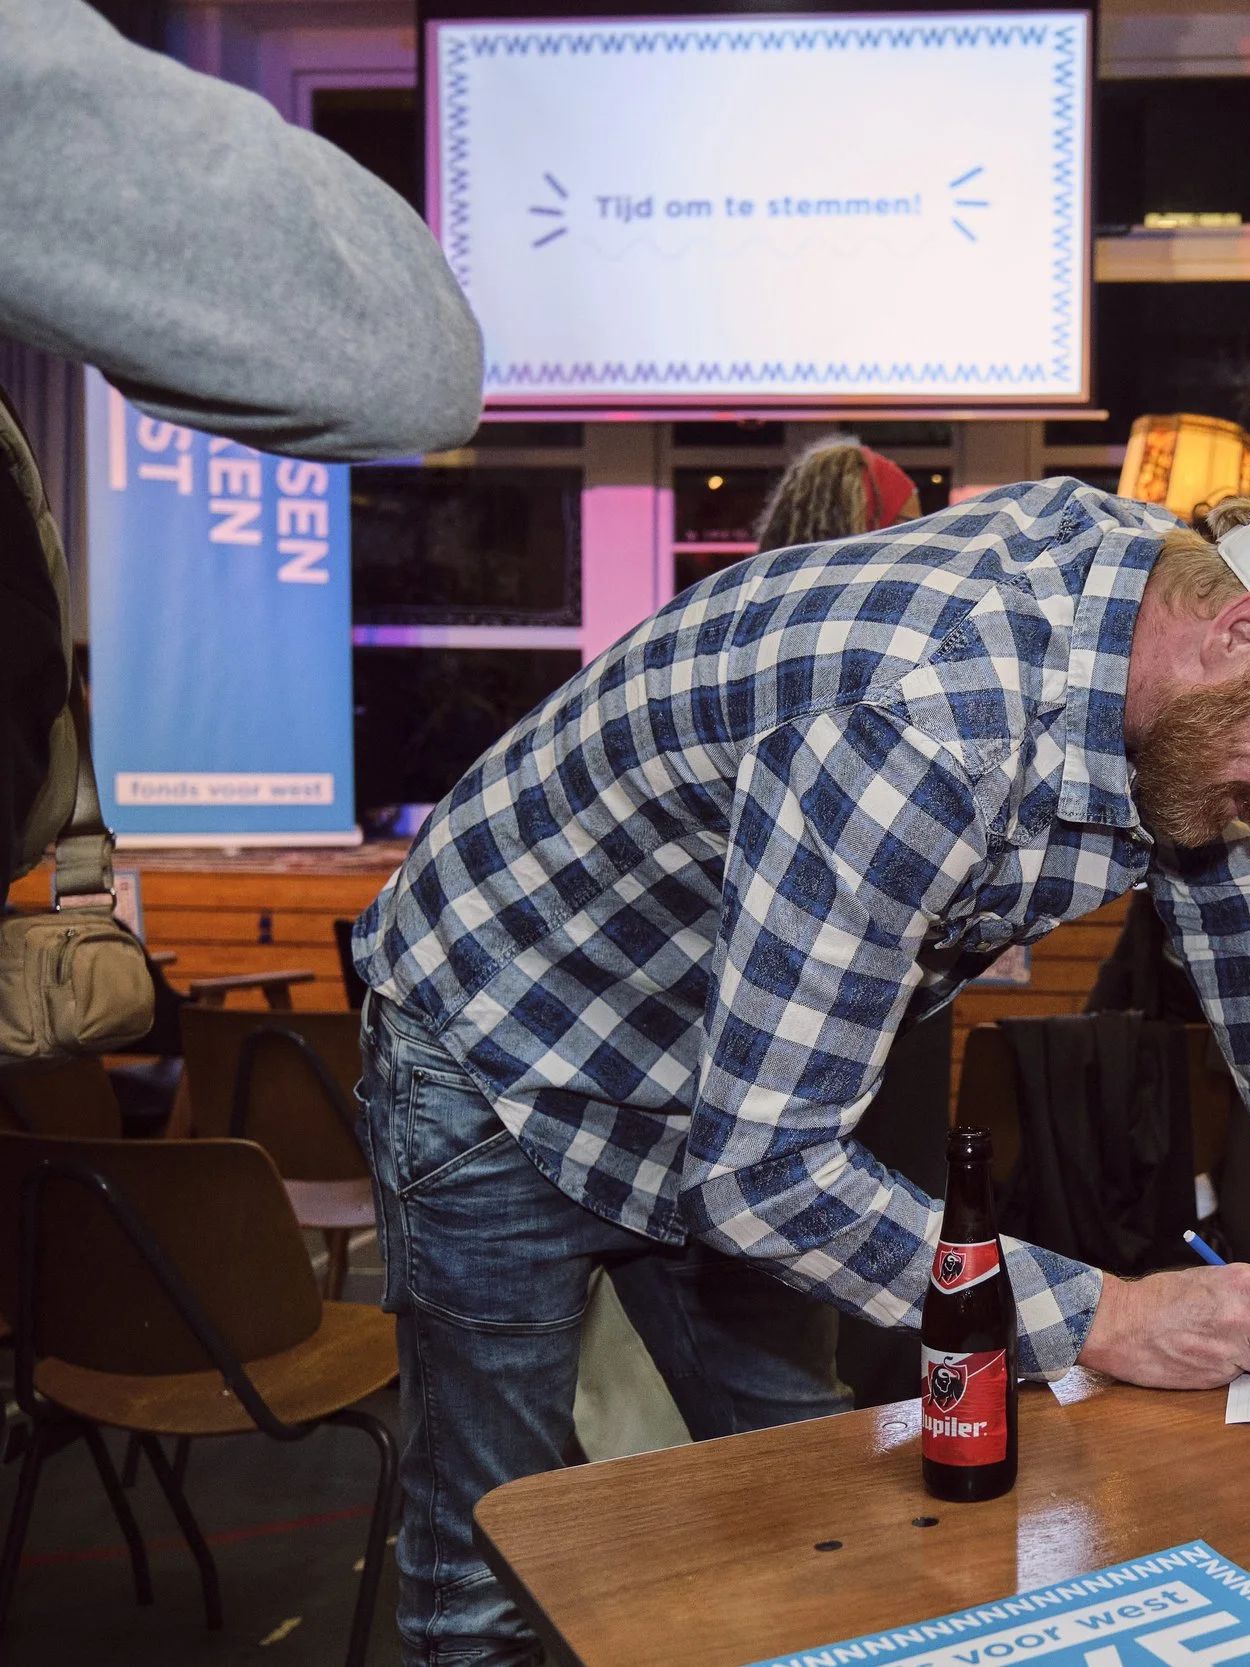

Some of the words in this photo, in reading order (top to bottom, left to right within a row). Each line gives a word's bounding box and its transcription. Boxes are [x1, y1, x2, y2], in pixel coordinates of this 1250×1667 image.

[596, 195, 654, 222] Tijd
[665, 199, 712, 218] om
[725, 195, 754, 217] te
[768, 192, 922, 218] stemmen!
[208, 783, 260, 797] voor
[271, 783, 322, 796] west
[952, 1625, 1063, 1665] voor
[1074, 1590, 1188, 1630] west
